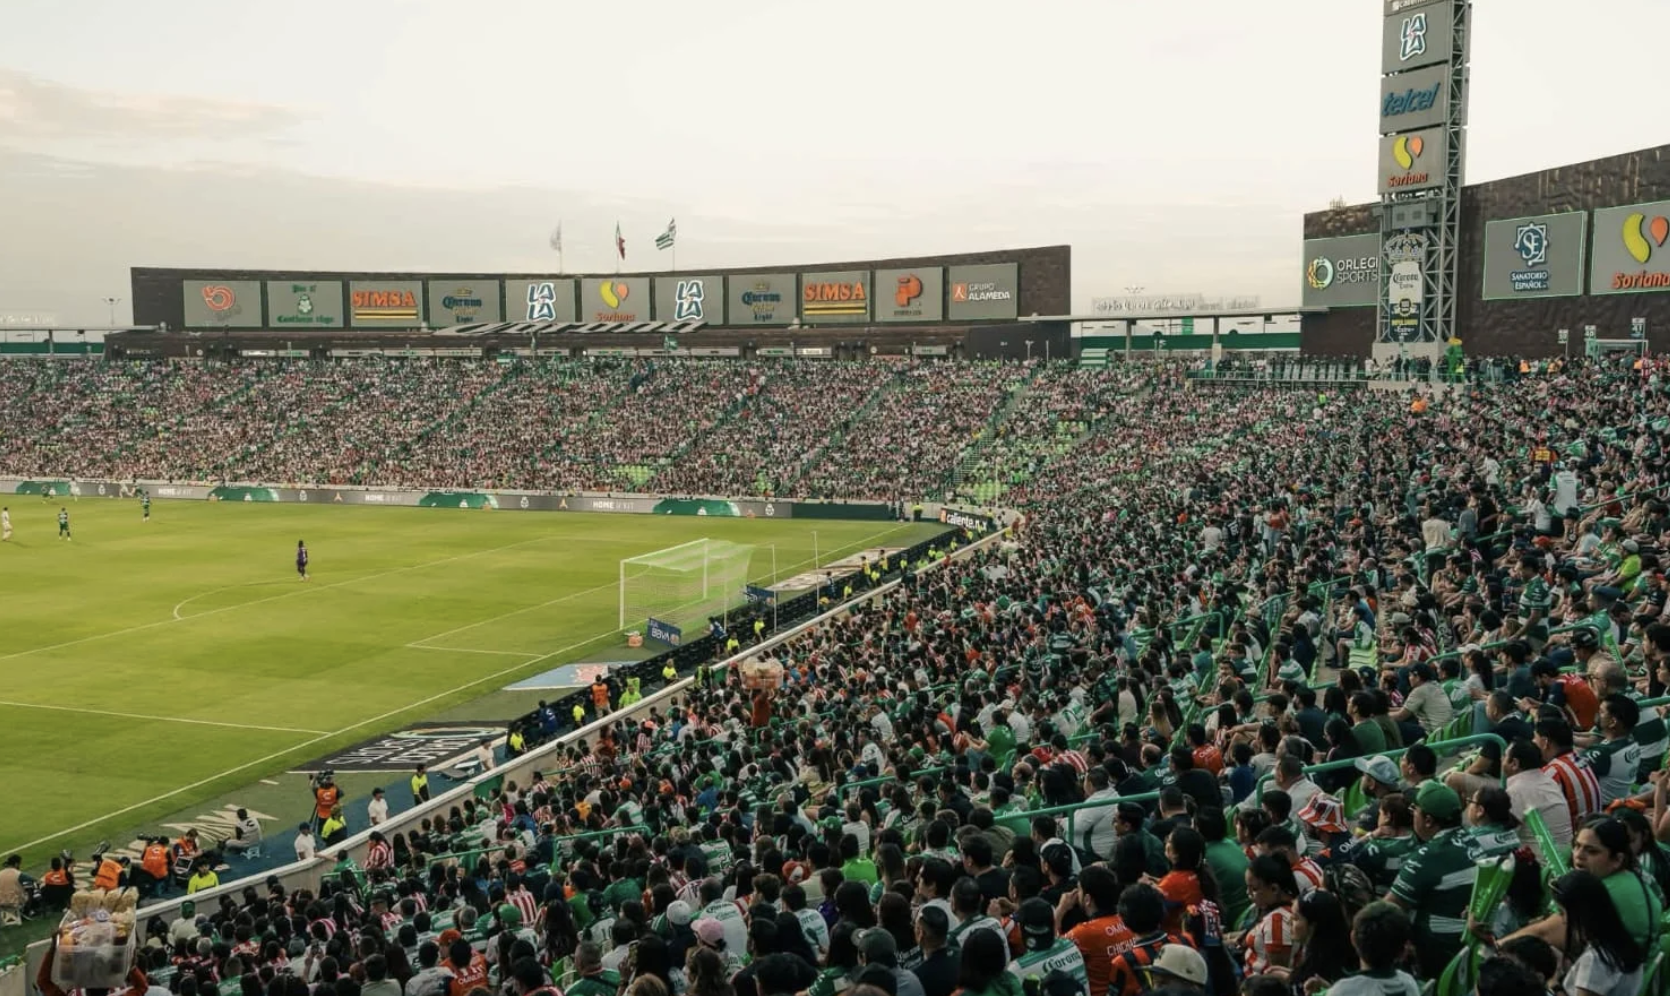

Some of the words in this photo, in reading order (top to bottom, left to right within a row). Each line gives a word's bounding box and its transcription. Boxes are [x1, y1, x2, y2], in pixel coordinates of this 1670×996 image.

[1382, 82, 1441, 117] telcel
[1511, 272, 1548, 281] SANATORIO
[1612, 270, 1670, 290] Soriana
[969, 283, 995, 292] GRUPO
[1515, 280, 1542, 290] ESPAÑOL
[805, 281, 865, 301] SIMSA
[968, 291, 1010, 301] ALAMEDA
[352, 290, 418, 307] SIMSA
[592, 500, 614, 509] HOME
